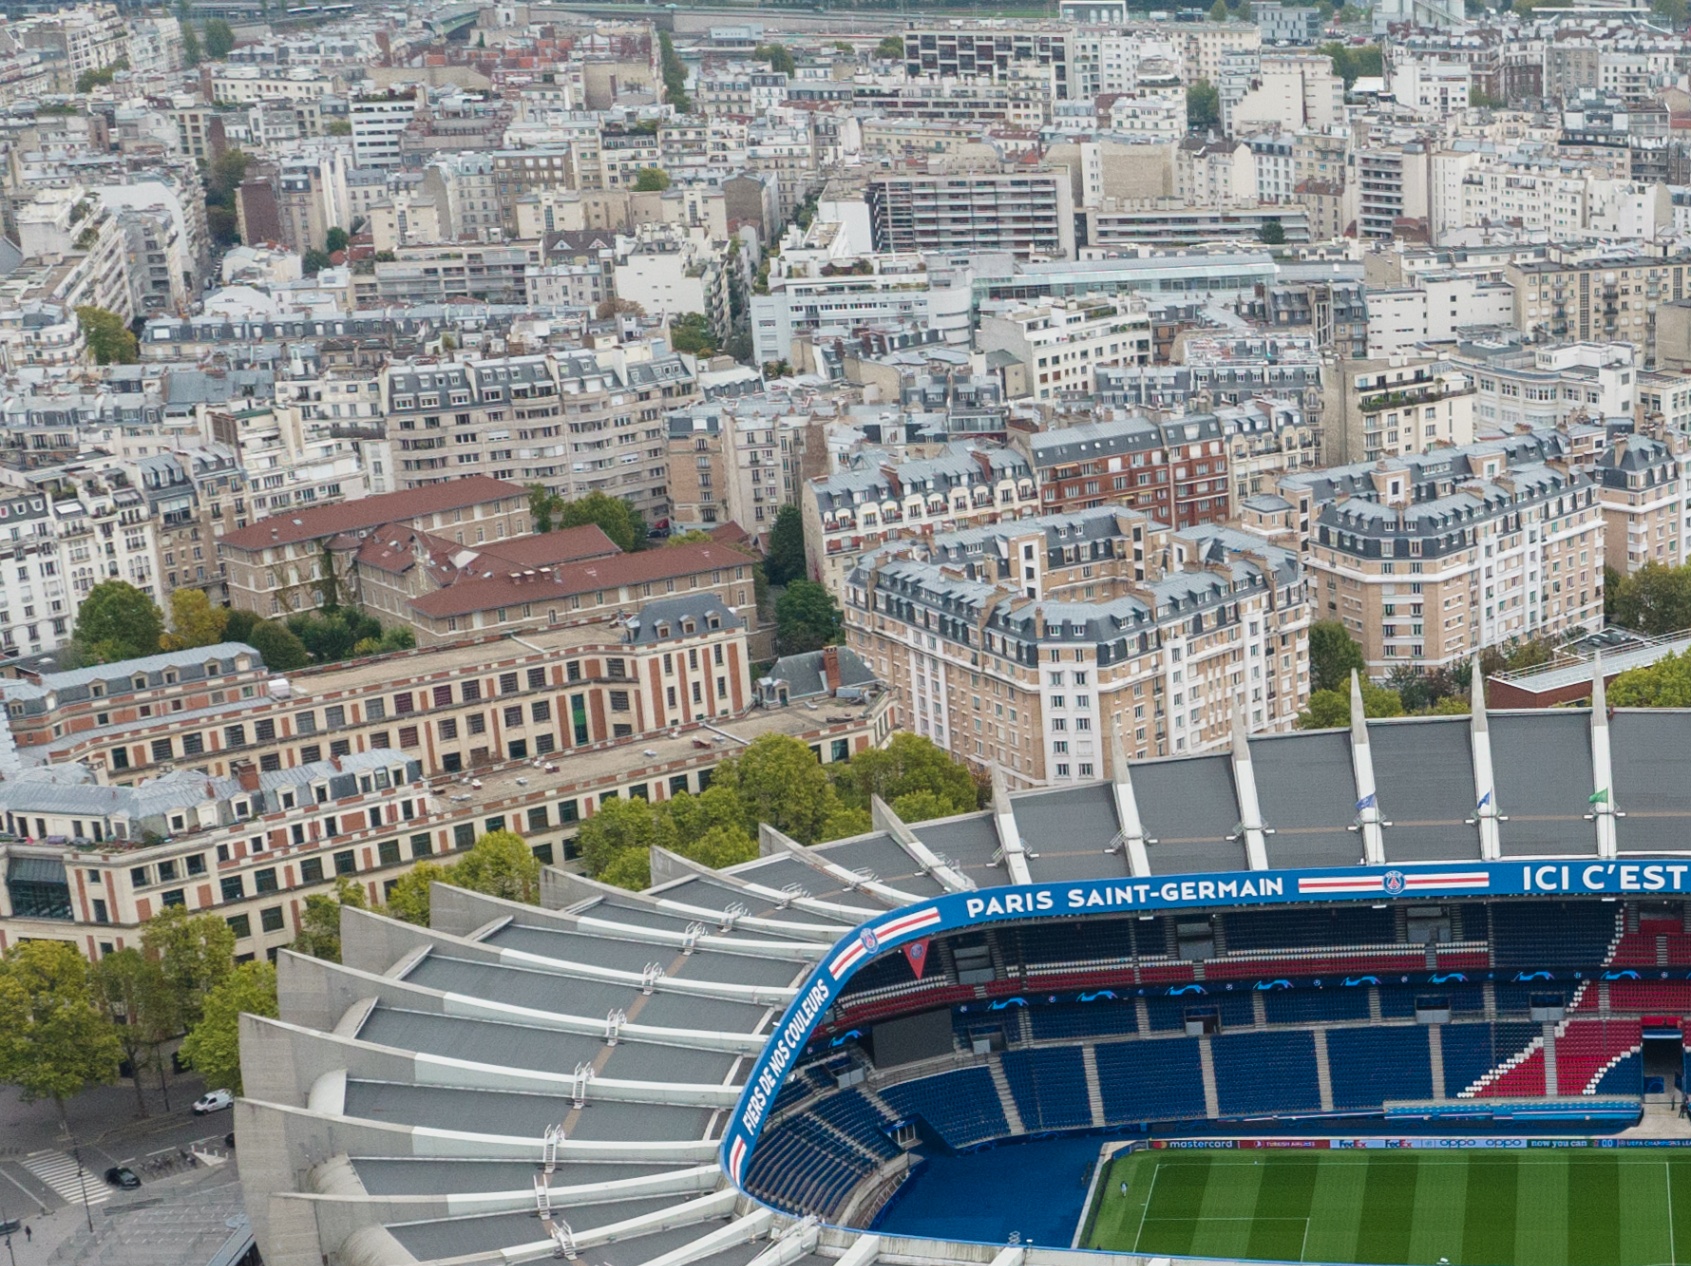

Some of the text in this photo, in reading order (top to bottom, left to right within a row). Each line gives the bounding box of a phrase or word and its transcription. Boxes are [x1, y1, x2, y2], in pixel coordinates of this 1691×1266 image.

[1523, 865, 1570, 891] ICI
[1582, 864, 1688, 891] C'EST
[966, 877, 1285, 919] PARIS SAINT-GERMAIN
[742, 978, 830, 1136] FIERS DE NOS COULEURS
[1169, 1139, 1233, 1149] mastercard
[1385, 1139, 1412, 1149] FedEx
[1440, 1139, 1476, 1148] oppo
[1485, 1138, 1522, 1148] oppo
